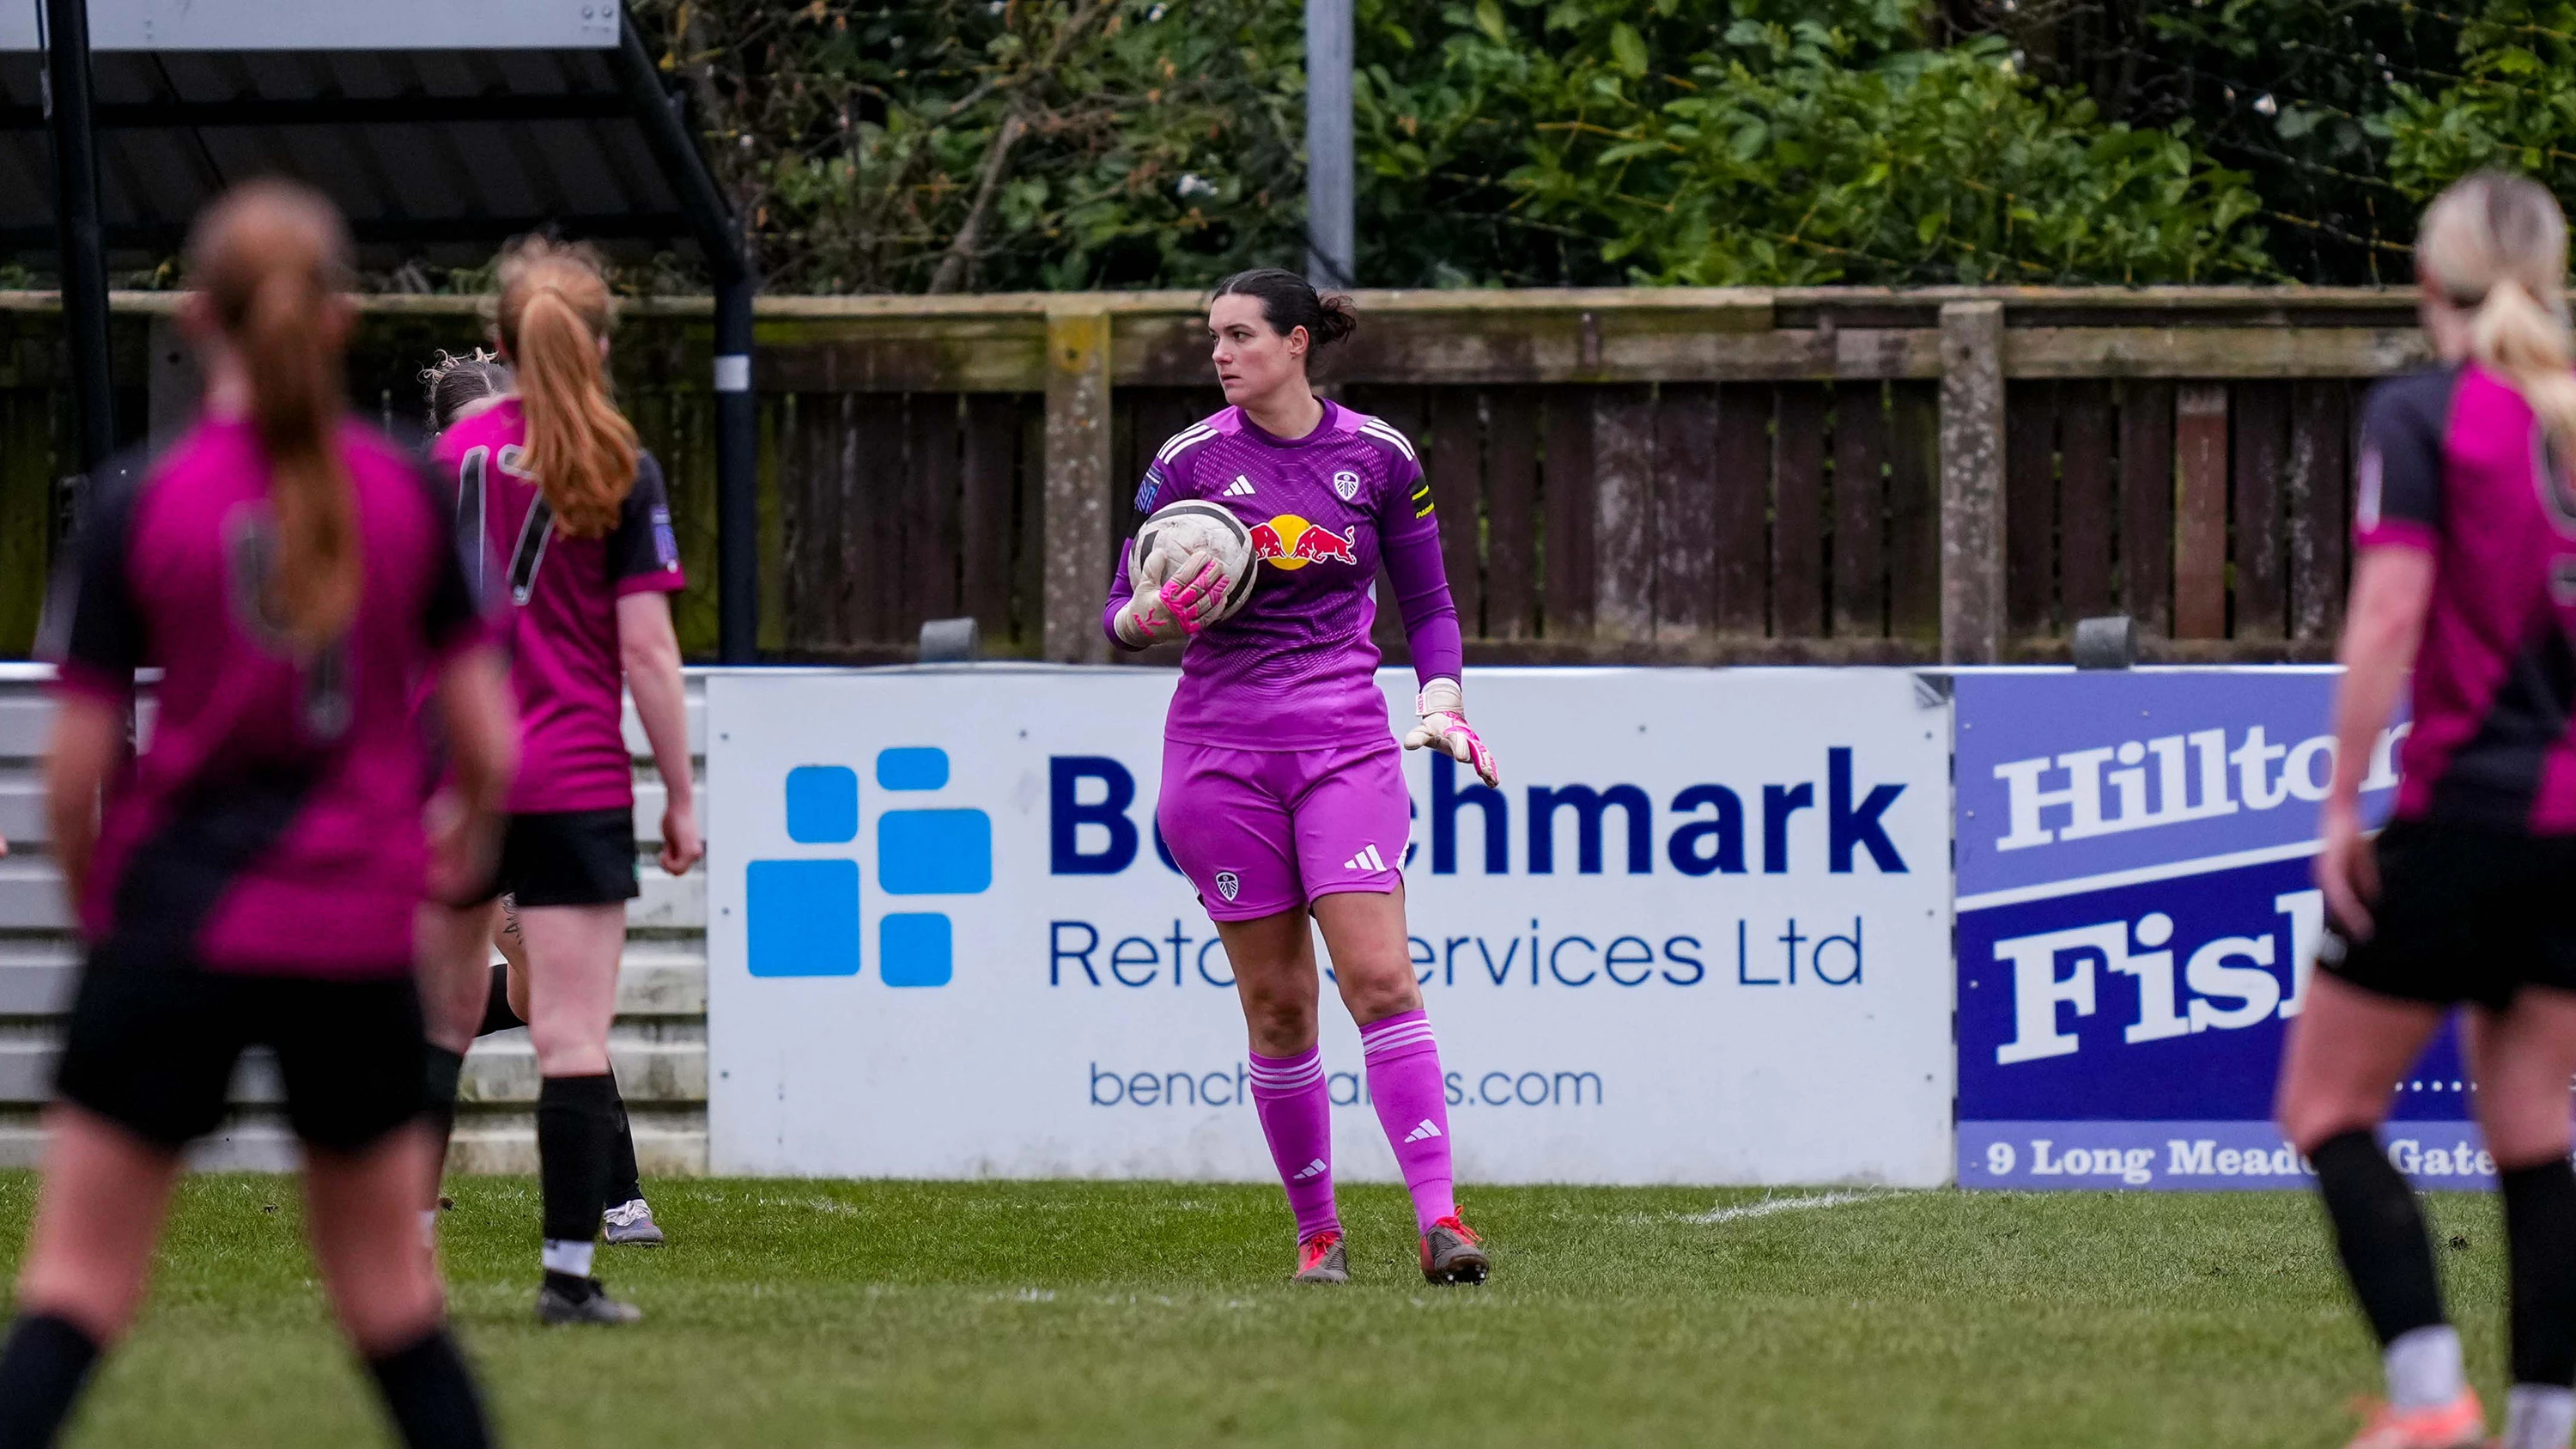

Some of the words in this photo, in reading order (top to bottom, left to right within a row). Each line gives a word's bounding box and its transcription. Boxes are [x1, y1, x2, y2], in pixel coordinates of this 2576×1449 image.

[1049, 746, 1911, 878] Bhmark
[1325, 918, 1705, 987] ervices
[1738, 916, 1862, 986] Ltd
[1987, 1142, 2016, 1176] 9
[2031, 1140, 2156, 1184] Long
[2166, 1140, 2318, 1177] Mead
[2388, 1139, 2499, 1177] Gate
